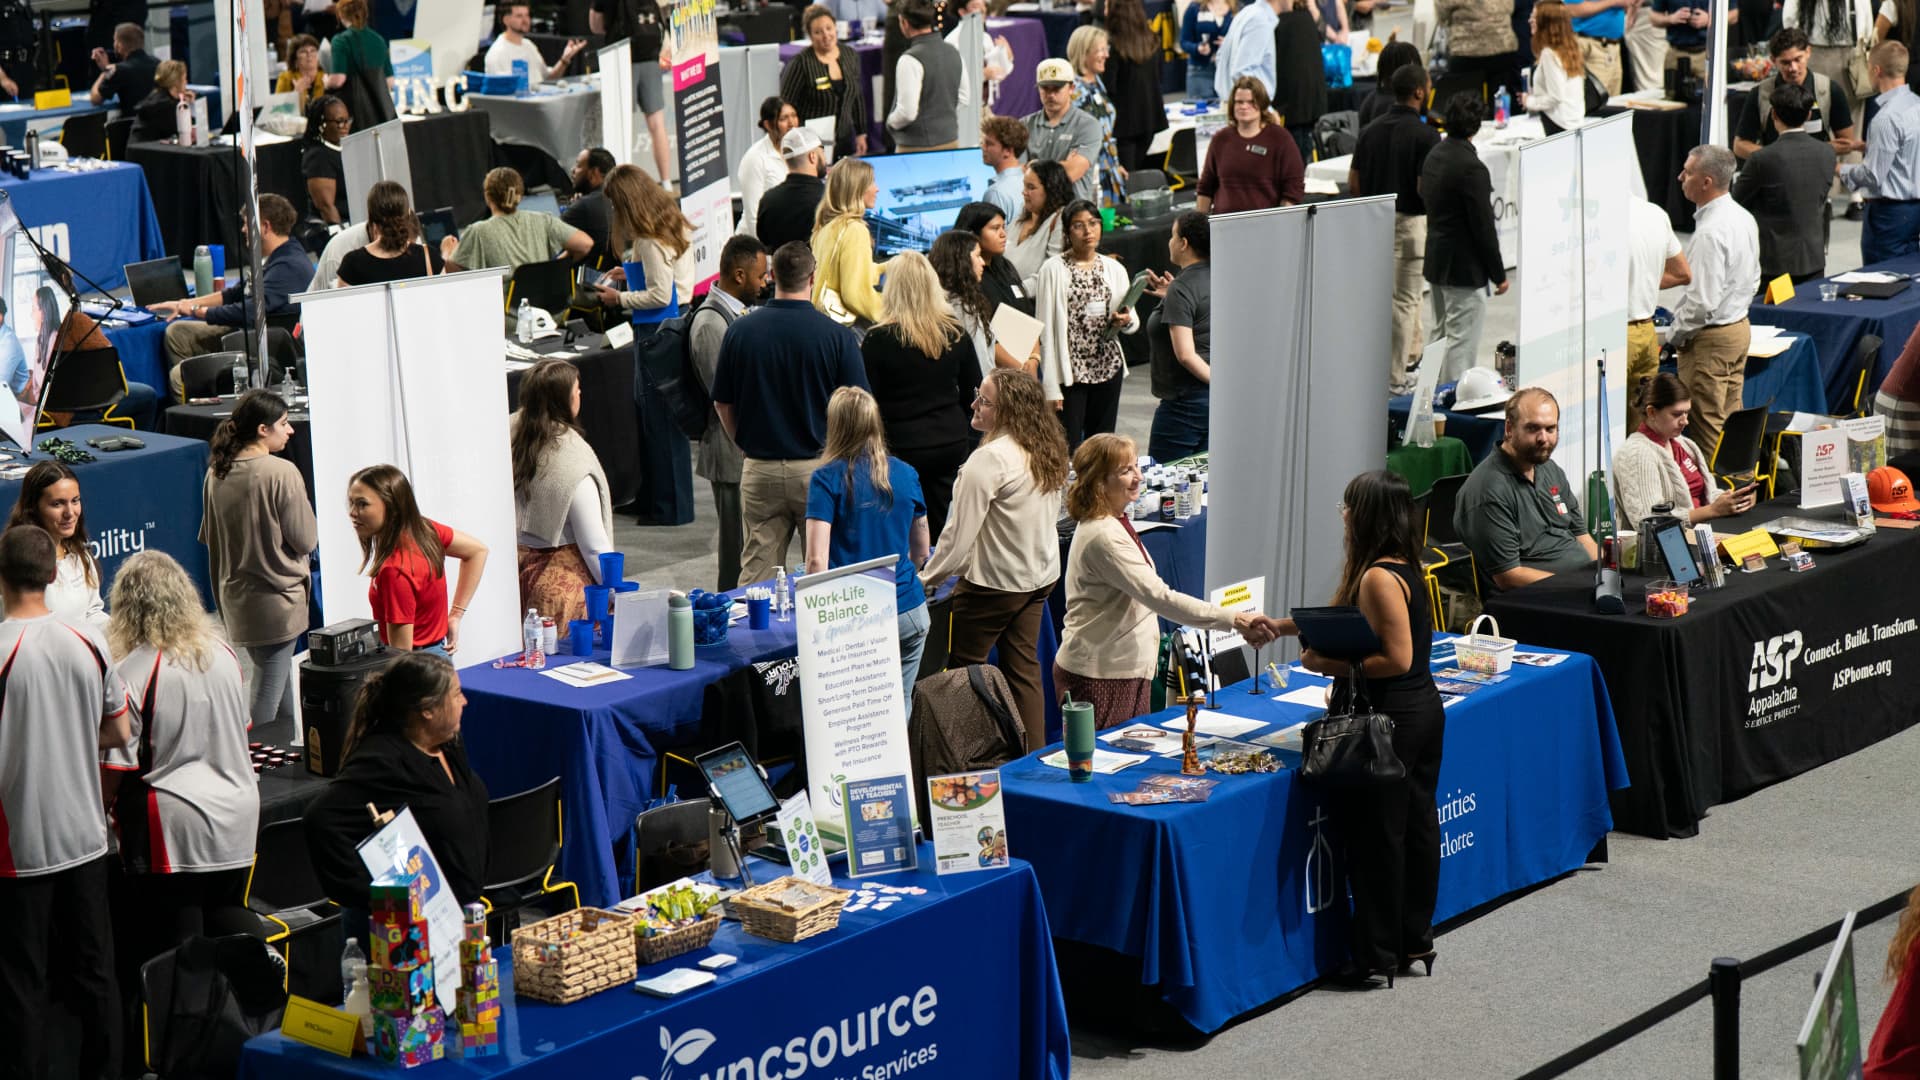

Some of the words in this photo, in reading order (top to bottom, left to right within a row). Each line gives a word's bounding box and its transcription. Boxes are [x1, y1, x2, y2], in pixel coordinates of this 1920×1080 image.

[1816, 443, 1835, 456] ASP
[804, 585, 865, 610] Work-Life
[817, 603, 868, 624] Balance
[817, 647, 840, 657] Medical
[845, 640, 865, 651] Dental
[1804, 639, 1842, 665] Connect.
[1844, 627, 1870, 651] Build.
[1872, 617, 1918, 642] Transform.
[848, 648, 877, 659] Insurance
[1748, 630, 1803, 692] ASP
[818, 666, 850, 678] Retirement
[851, 663, 864, 671] Plan
[1832, 659, 1892, 690] ASPhome.org
[825, 679, 853, 690] Education
[855, 672, 887, 683] Assistance
[823, 705, 851, 716] Generous
[852, 701, 865, 709] Paid
[867, 698, 881, 706] Time
[883, 694, 892, 703] Off
[1748, 685, 1798, 717] Appalachia
[858, 709, 889, 720] Assistance
[1744, 714, 1773, 729] SERVICE
[846, 721, 872, 732] Program
[861, 731, 886, 742] Program
[853, 753, 882, 765] Insurance
[861, 1043, 938, 1080] Services
